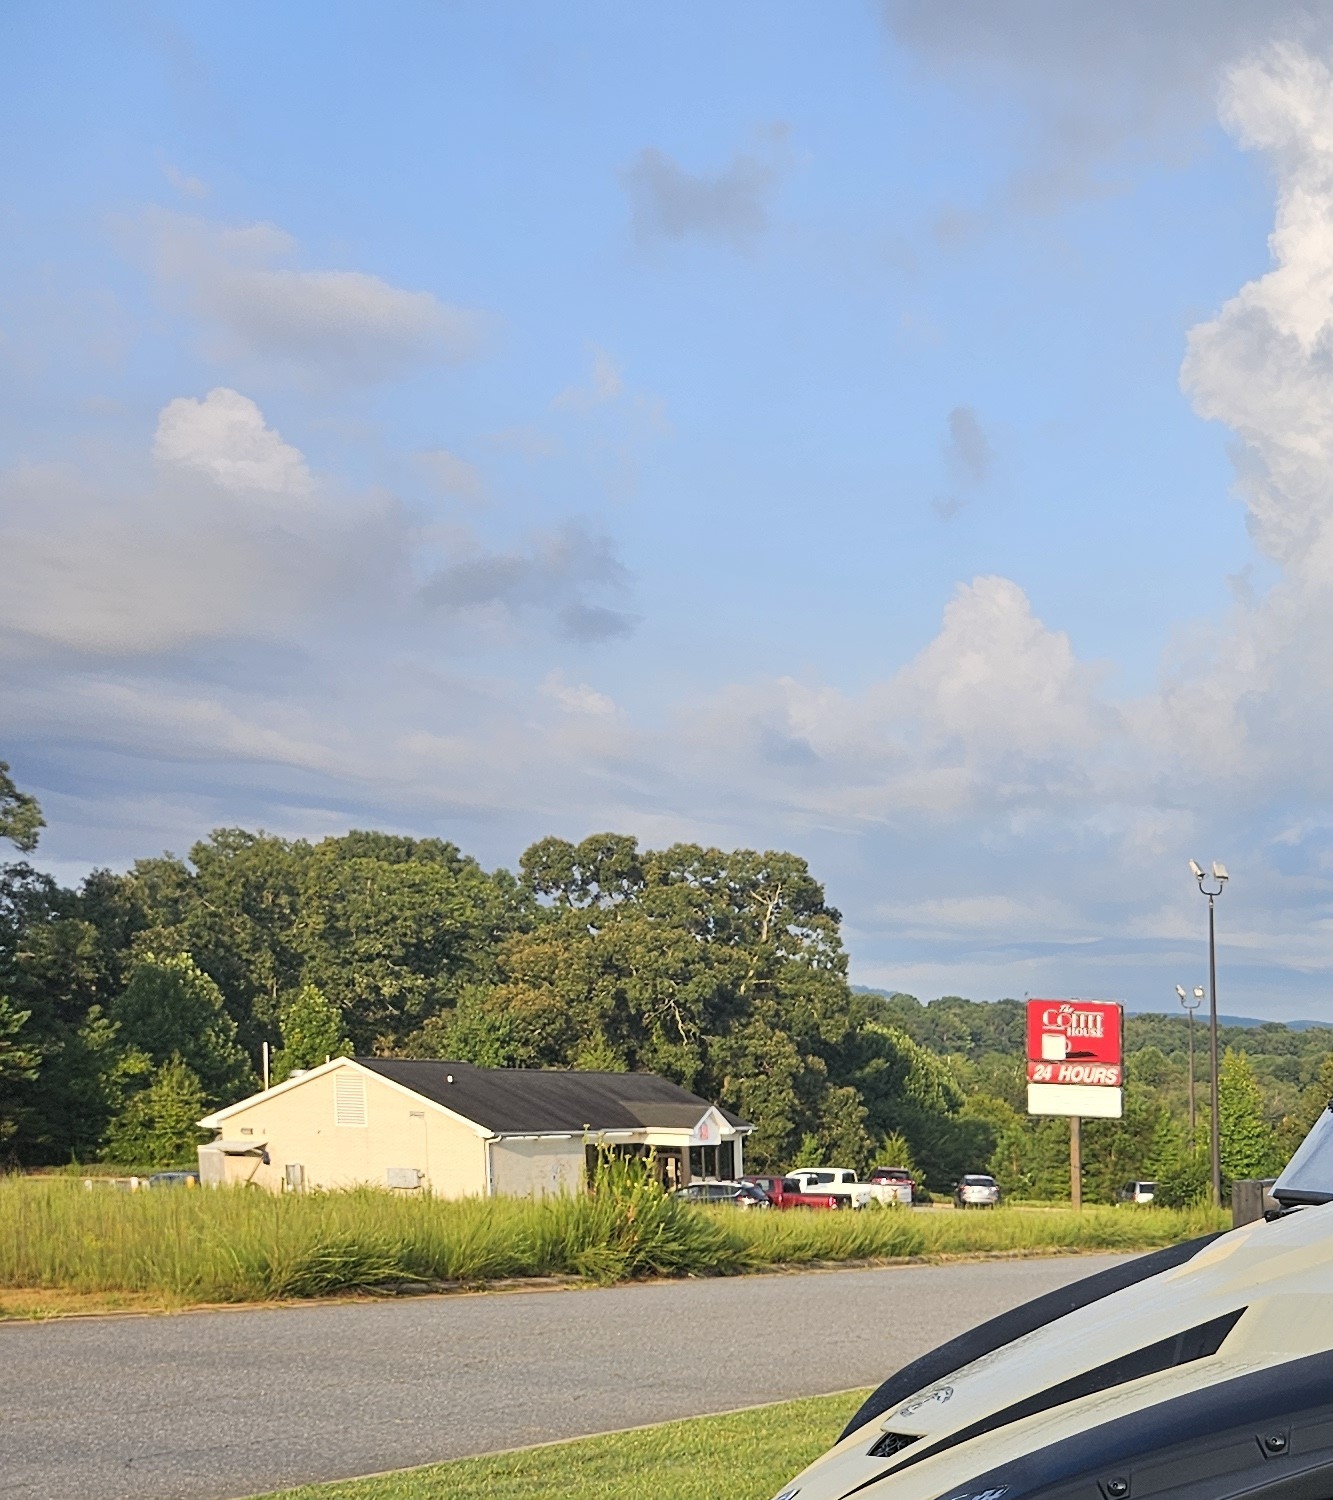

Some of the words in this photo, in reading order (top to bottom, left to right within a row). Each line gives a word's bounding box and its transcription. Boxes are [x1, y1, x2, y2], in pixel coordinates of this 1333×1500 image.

[1066, 1027, 1105, 1038] HOUSE
[1032, 1064, 1053, 1081] 24
[1057, 1065, 1119, 1085] HOURS
